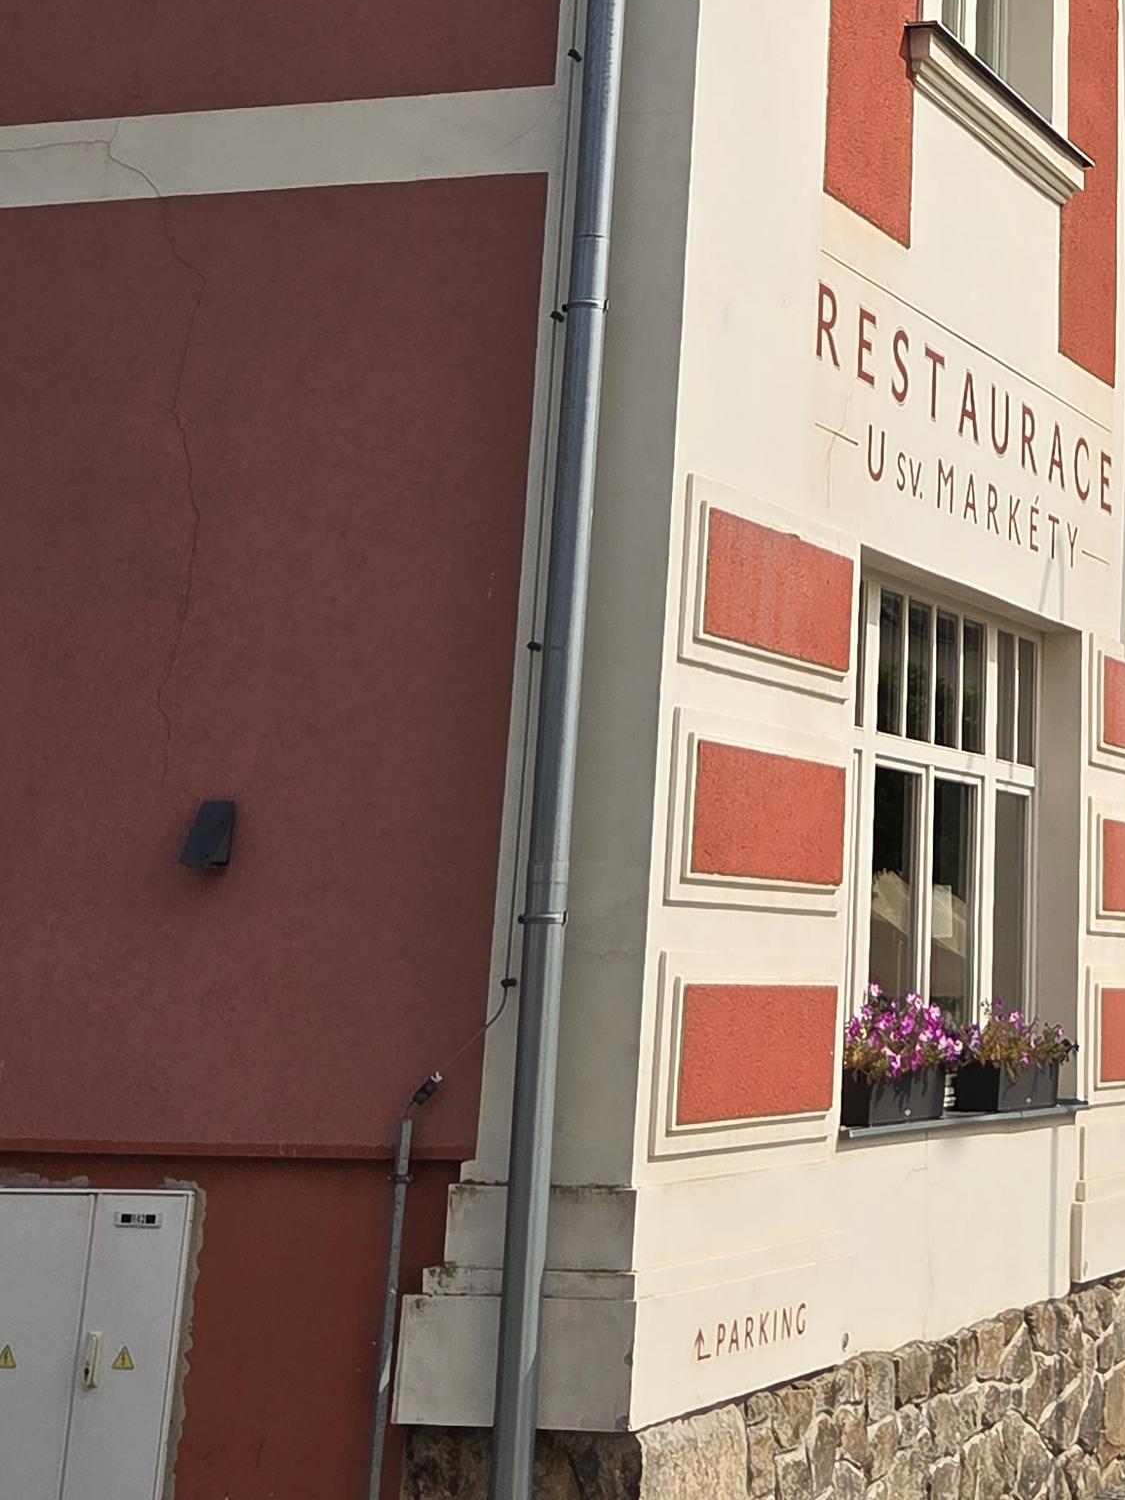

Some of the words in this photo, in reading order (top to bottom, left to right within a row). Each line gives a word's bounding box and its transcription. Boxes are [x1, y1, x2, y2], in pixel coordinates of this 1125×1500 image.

[815, 281, 1112, 515] RESTAURACE
[867, 423, 885, 482] U
[937, 457, 1079, 568] MARKÉTY
[716, 1302, 807, 1357] PARKING
